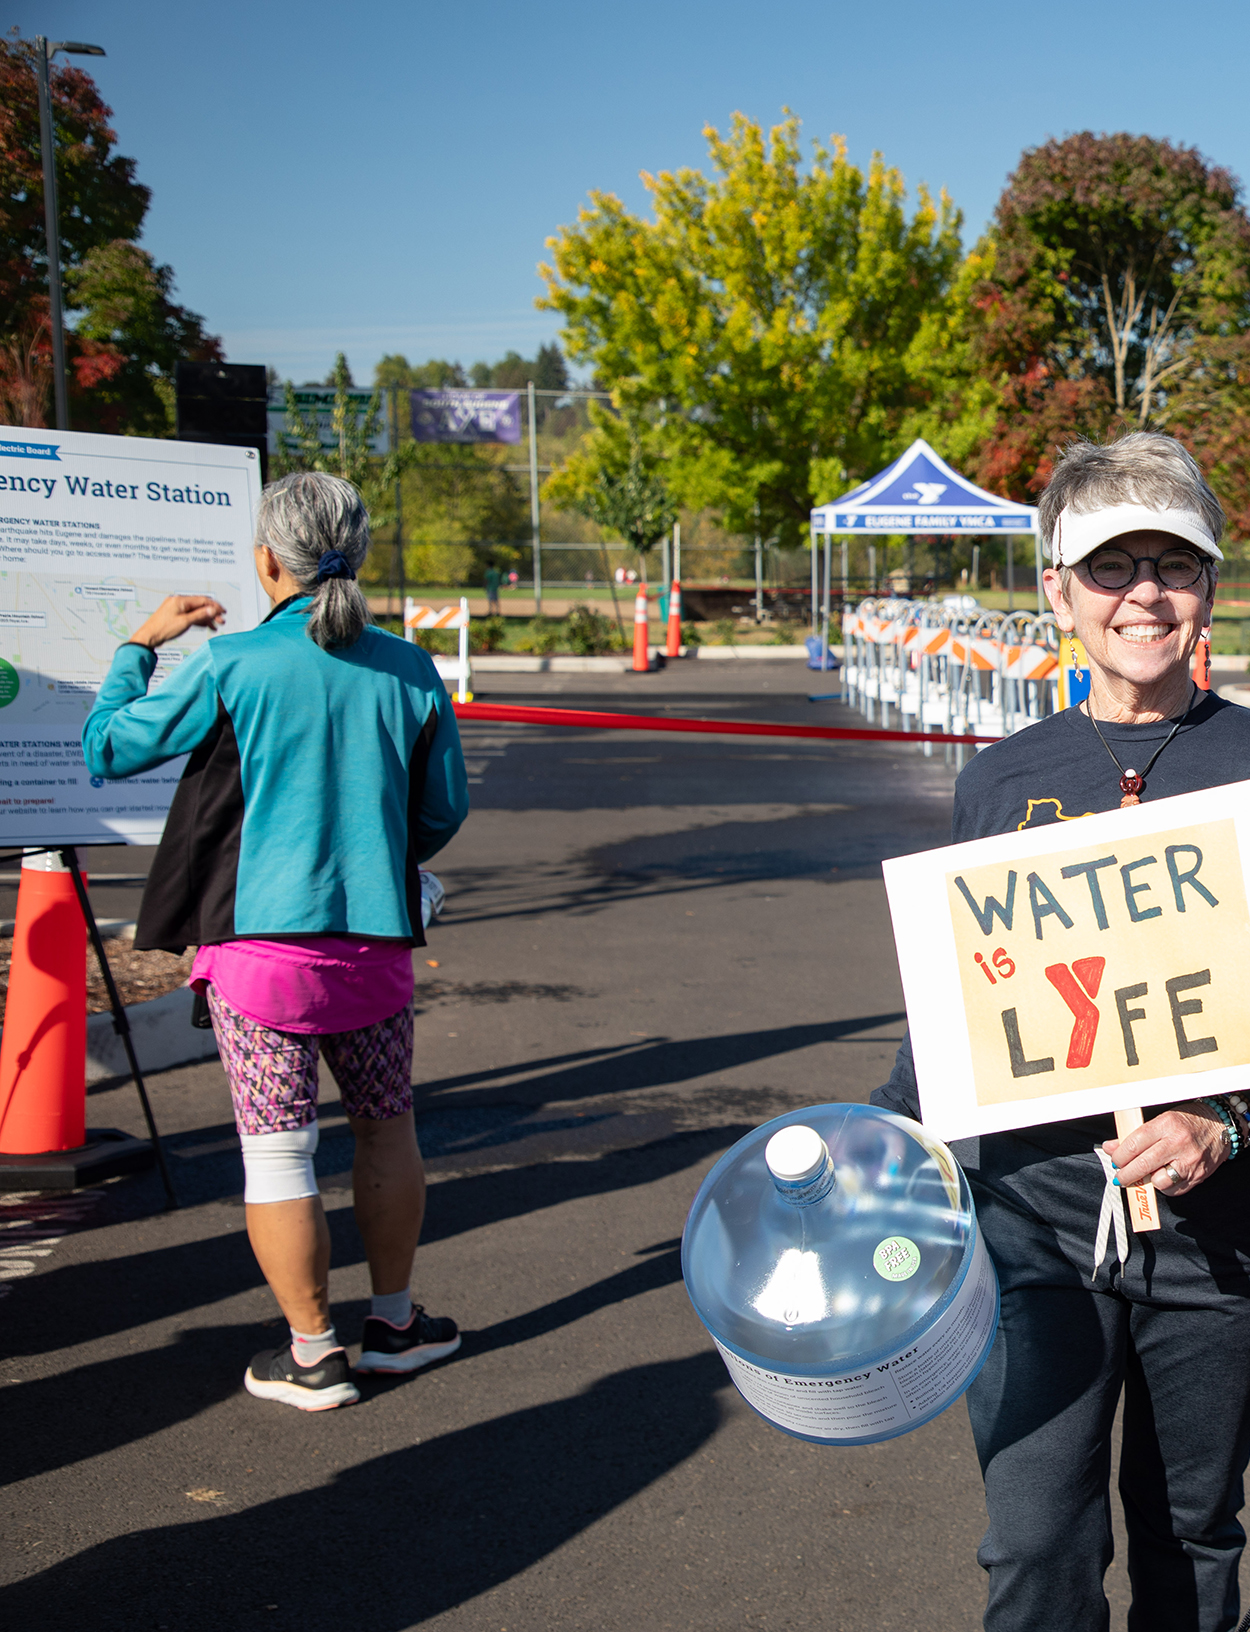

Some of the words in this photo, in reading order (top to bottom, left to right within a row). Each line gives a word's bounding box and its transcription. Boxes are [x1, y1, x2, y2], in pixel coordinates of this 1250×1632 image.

[26, 445, 52, 456] Board
[63, 475, 139, 500] Water
[146, 481, 232, 507] Station
[32, 518, 60, 527] WATER
[62, 520, 101, 530] STATIONS
[864, 514, 913, 528] EUGENE
[914, 514, 957, 528] FAMILY
[958, 514, 996, 528] YMCA
[39, 528, 54, 536] hits
[54, 529, 82, 538] Eugene
[84, 531, 97, 539] and
[24, 546, 48, 554] should
[50, 548, 64, 556] you
[22, 740, 61, 748] STATIONS
[63, 740, 82, 748] WOR
[16, 750, 24, 758] of
[20, 778, 56, 786] container
[58, 778, 66, 786] to
[161, 776, 180, 784] befo
[8, 806, 38, 815] website
[954, 844, 1219, 940] WATER
[974, 947, 1016, 985] is
[1001, 956, 1219, 1078] LYFE
[879, 1240, 901, 1260] BPA
[884, 1246, 911, 1272] FREE
[783, 1372, 871, 1388] Emergency
[876, 1346, 918, 1373] Water
[830, 1392, 864, 1401] household
[864, 1384, 886, 1395] bleach
[866, 1396, 888, 1406] bleach
